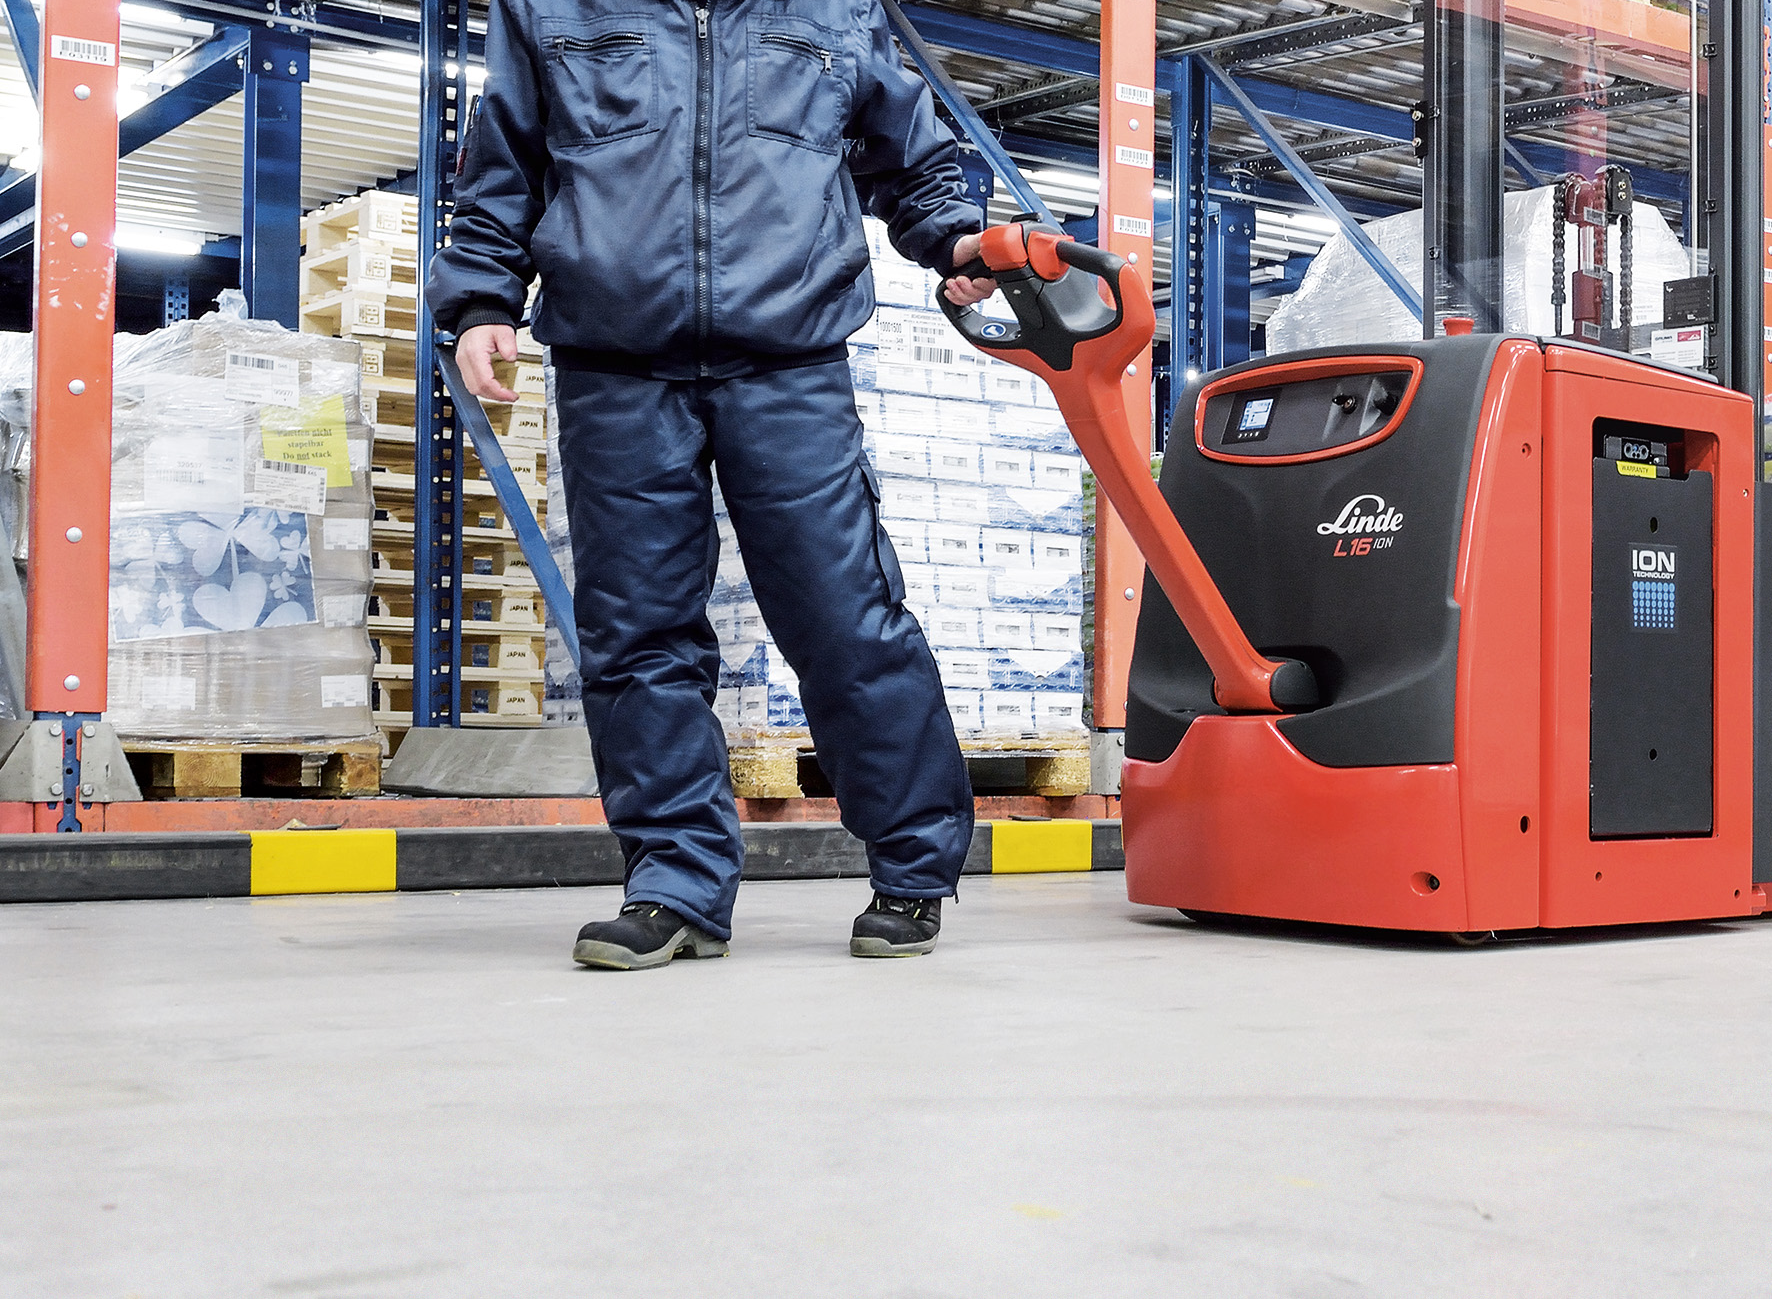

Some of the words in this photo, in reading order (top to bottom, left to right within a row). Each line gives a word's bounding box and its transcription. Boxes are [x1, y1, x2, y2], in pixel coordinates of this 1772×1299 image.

[525, 375, 545, 383] JAPAN
[518, 420, 538, 429] JAPAN
[311, 428, 332, 437] nicht
[287, 440, 324, 449] stapelbar
[282, 452, 295, 460] Do
[296, 452, 310, 461] not
[311, 450, 332, 459] stack
[1621, 465, 1649, 474] WARRANTY
[1316, 494, 1404, 535] Linde
[1373, 536, 1394, 549] ION
[509, 560, 529, 568] JAPAN
[1632, 549, 1675, 573] ION
[1632, 570, 1675, 580] TECHNOLOGY
[509, 605, 529, 613] JAPAN
[506, 651, 526, 659] JAPAN
[506, 696, 526, 704] JAPAN
